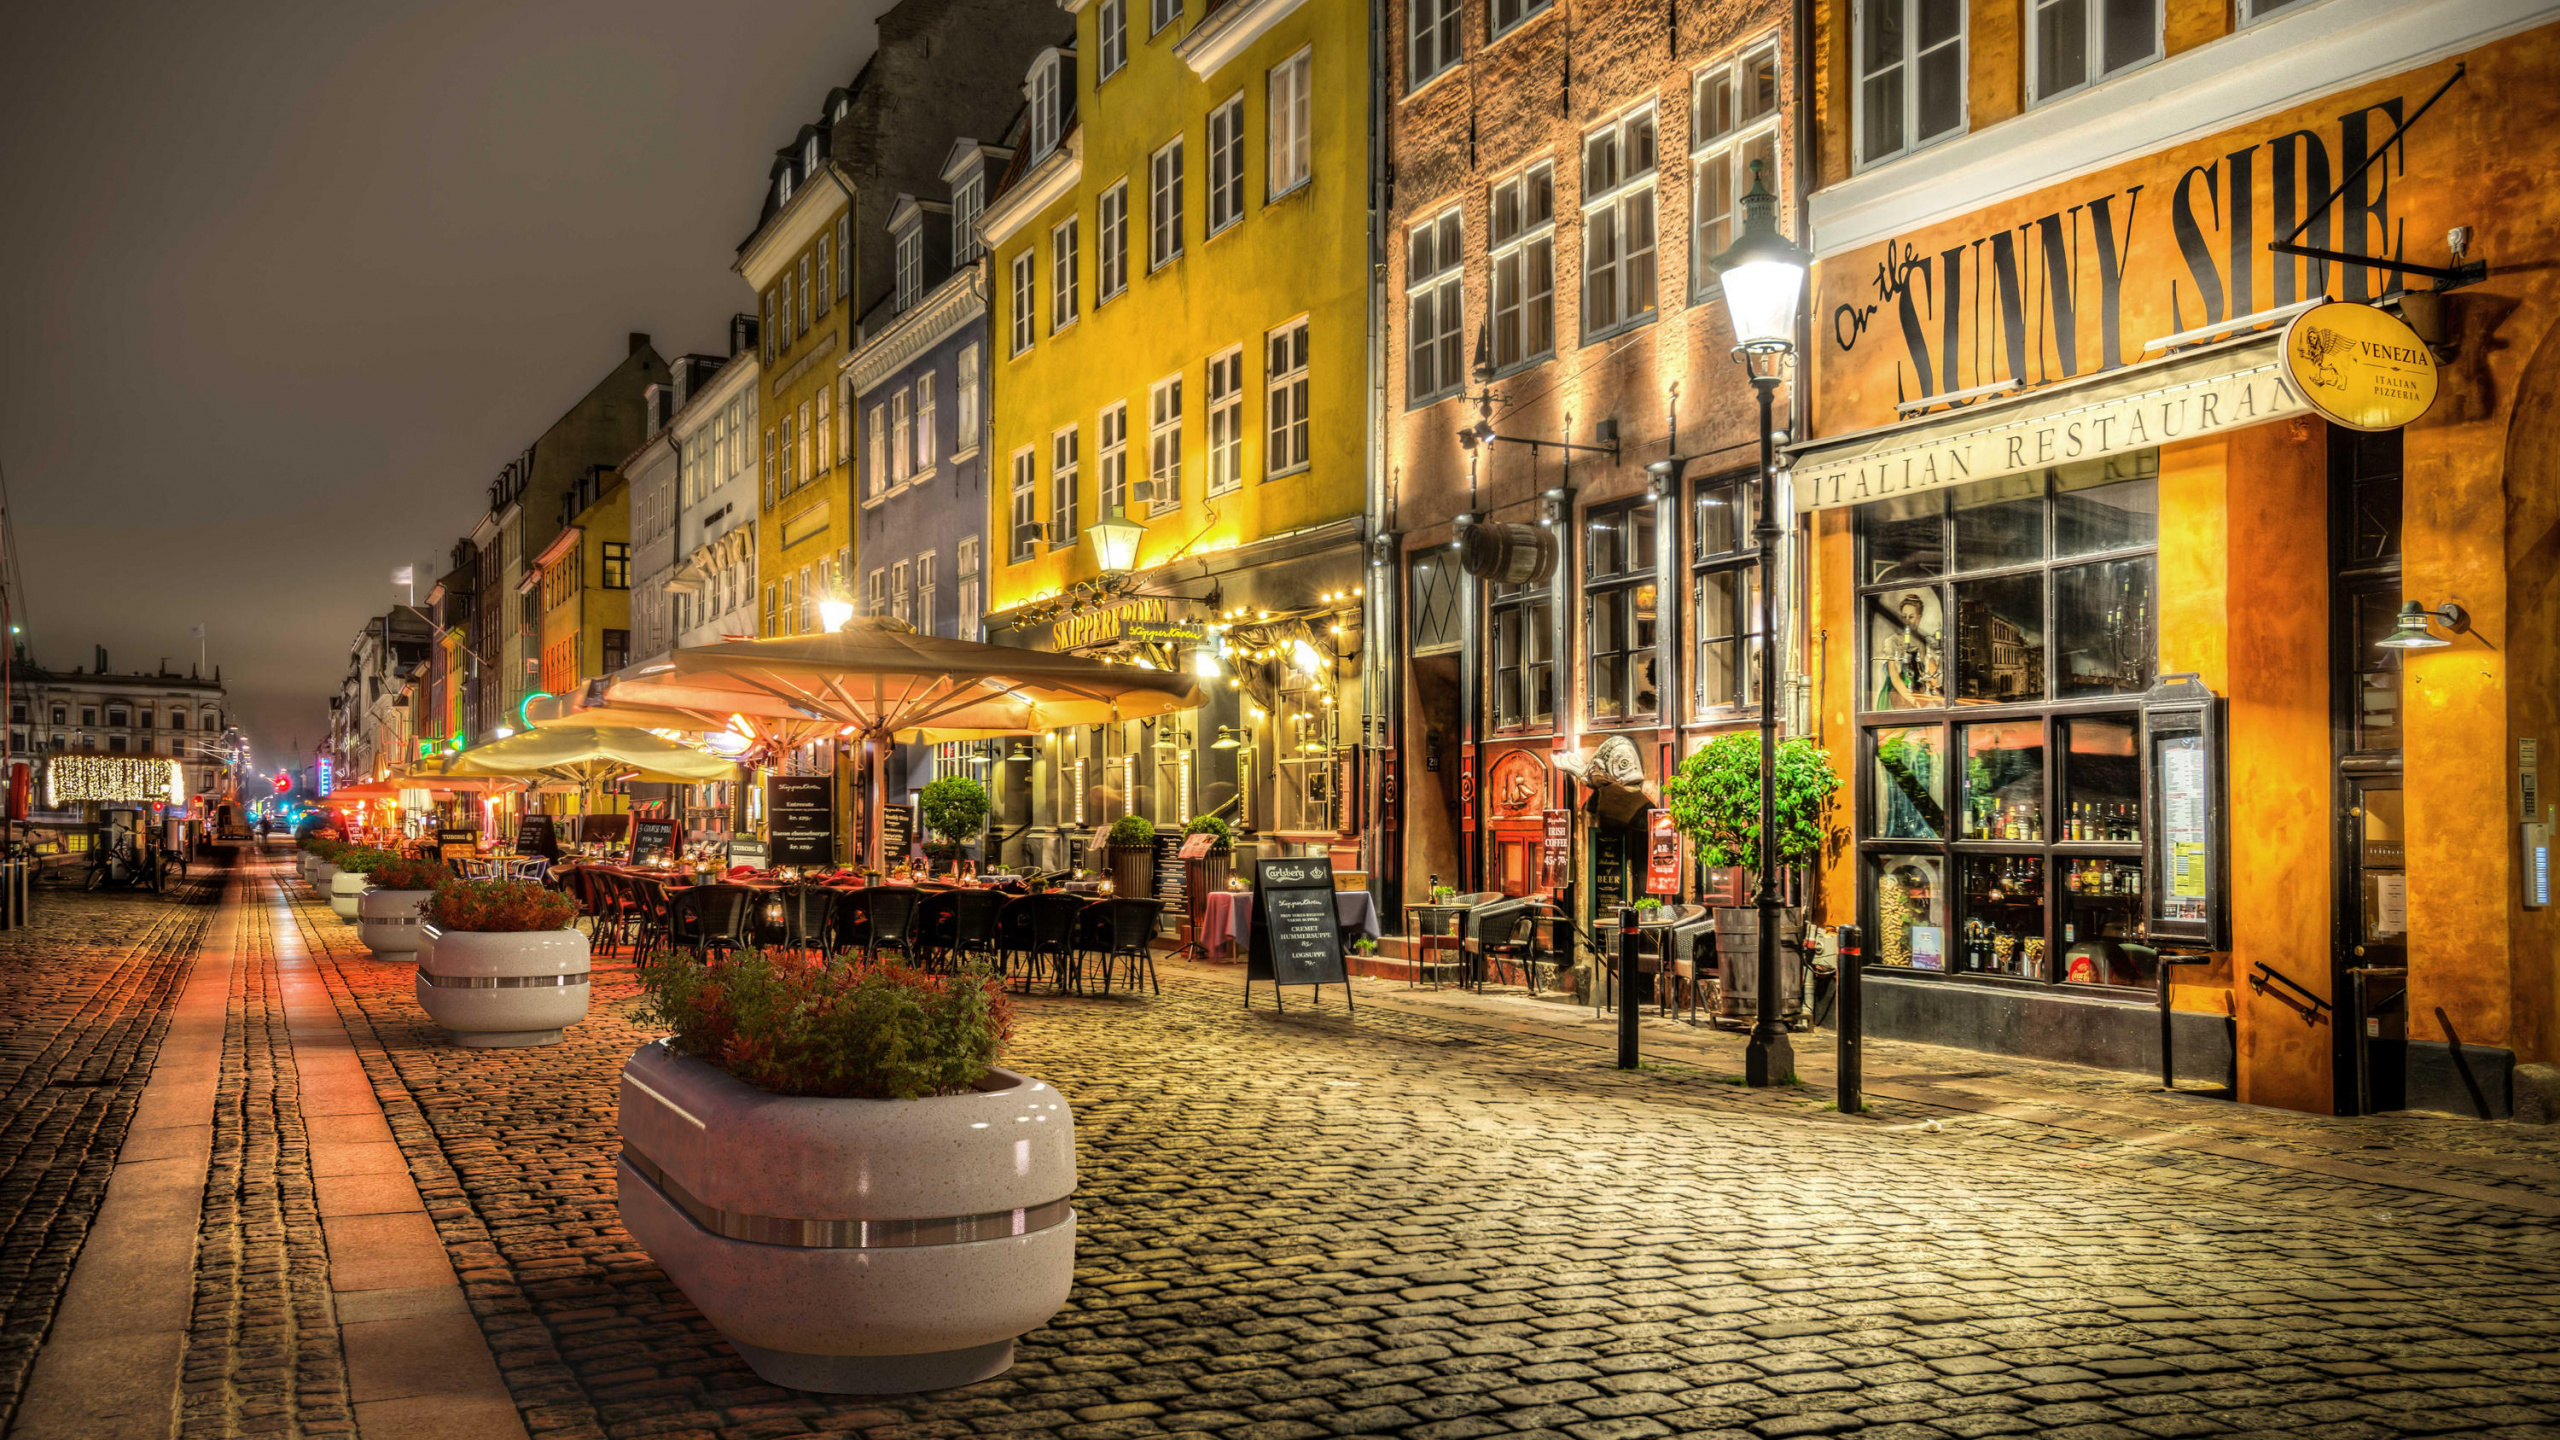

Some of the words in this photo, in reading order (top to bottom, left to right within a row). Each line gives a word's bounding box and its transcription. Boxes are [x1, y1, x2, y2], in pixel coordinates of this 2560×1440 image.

[1896, 184, 2145, 421] SUNNY
[2172, 96, 2404, 352] SIDE
[1834, 303, 1877, 351] On
[1873, 238, 1919, 303] the
[2360, 341, 2428, 366] VENEZIA
[2375, 375, 2417, 390] ITALIAN
[2374, 386, 2420, 402] PIZZERIA
[1811, 446, 1971, 506] ITALIAN
[2005, 376, 2297, 470] RESTAURAN
[1548, 827, 1566, 836] IRISH
[1545, 838, 1567, 847] COFFEE
[1266, 866, 1304, 882] Carlsberg
[1597, 875, 1620, 883] BEER
[1280, 932, 1332, 940] HUMMERSUPPE
